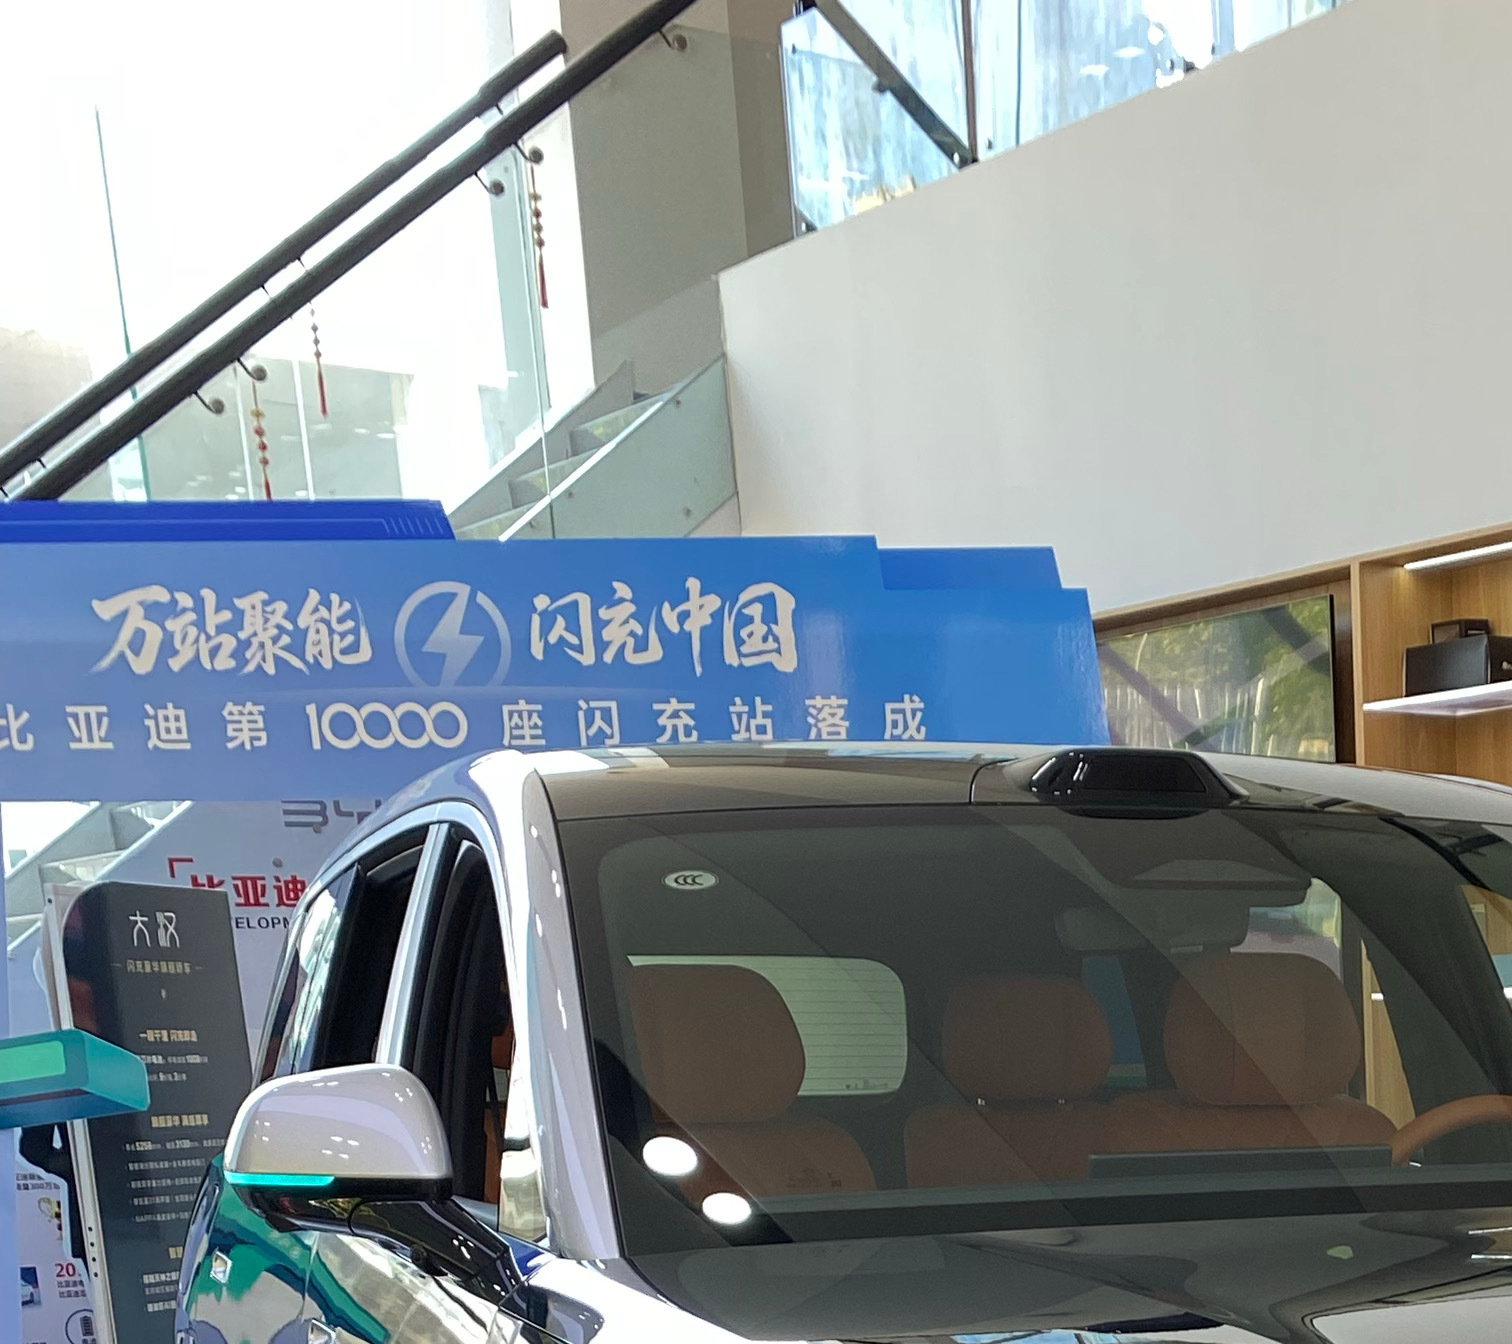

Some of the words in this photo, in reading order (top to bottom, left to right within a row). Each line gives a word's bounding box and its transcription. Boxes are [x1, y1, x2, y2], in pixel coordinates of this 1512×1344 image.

[88, 584, 373, 677] 万站聚能
[530, 576, 799, 678] 闪充中国
